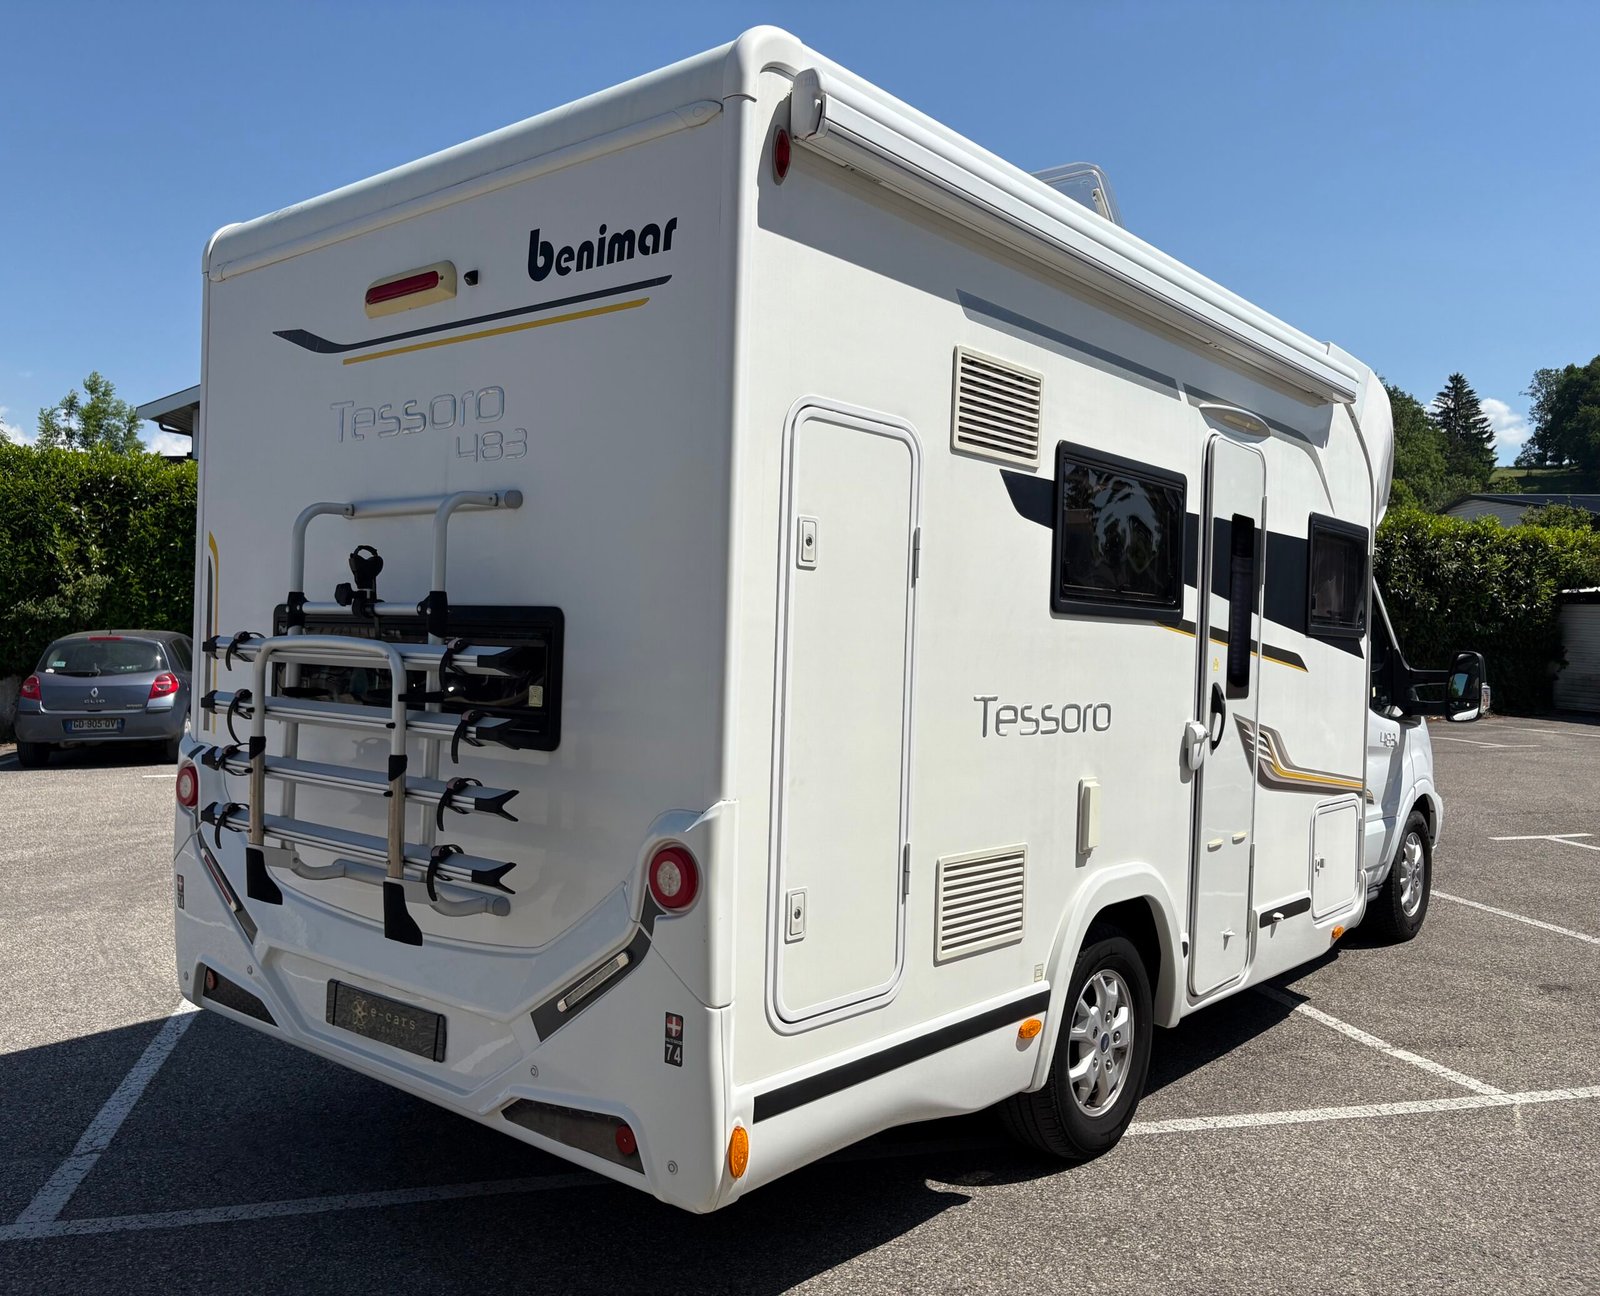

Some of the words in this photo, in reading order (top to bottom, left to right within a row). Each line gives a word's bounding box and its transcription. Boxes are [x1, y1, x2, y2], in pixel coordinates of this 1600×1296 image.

[528, 217, 677, 282] benimar
[330, 386, 505, 443] Tessoro
[456, 428, 528, 462] 483
[973, 695, 1111, 738] Tessoro
[371, 1008, 416, 1031] e-cars
[666, 1043, 682, 1064] 74
